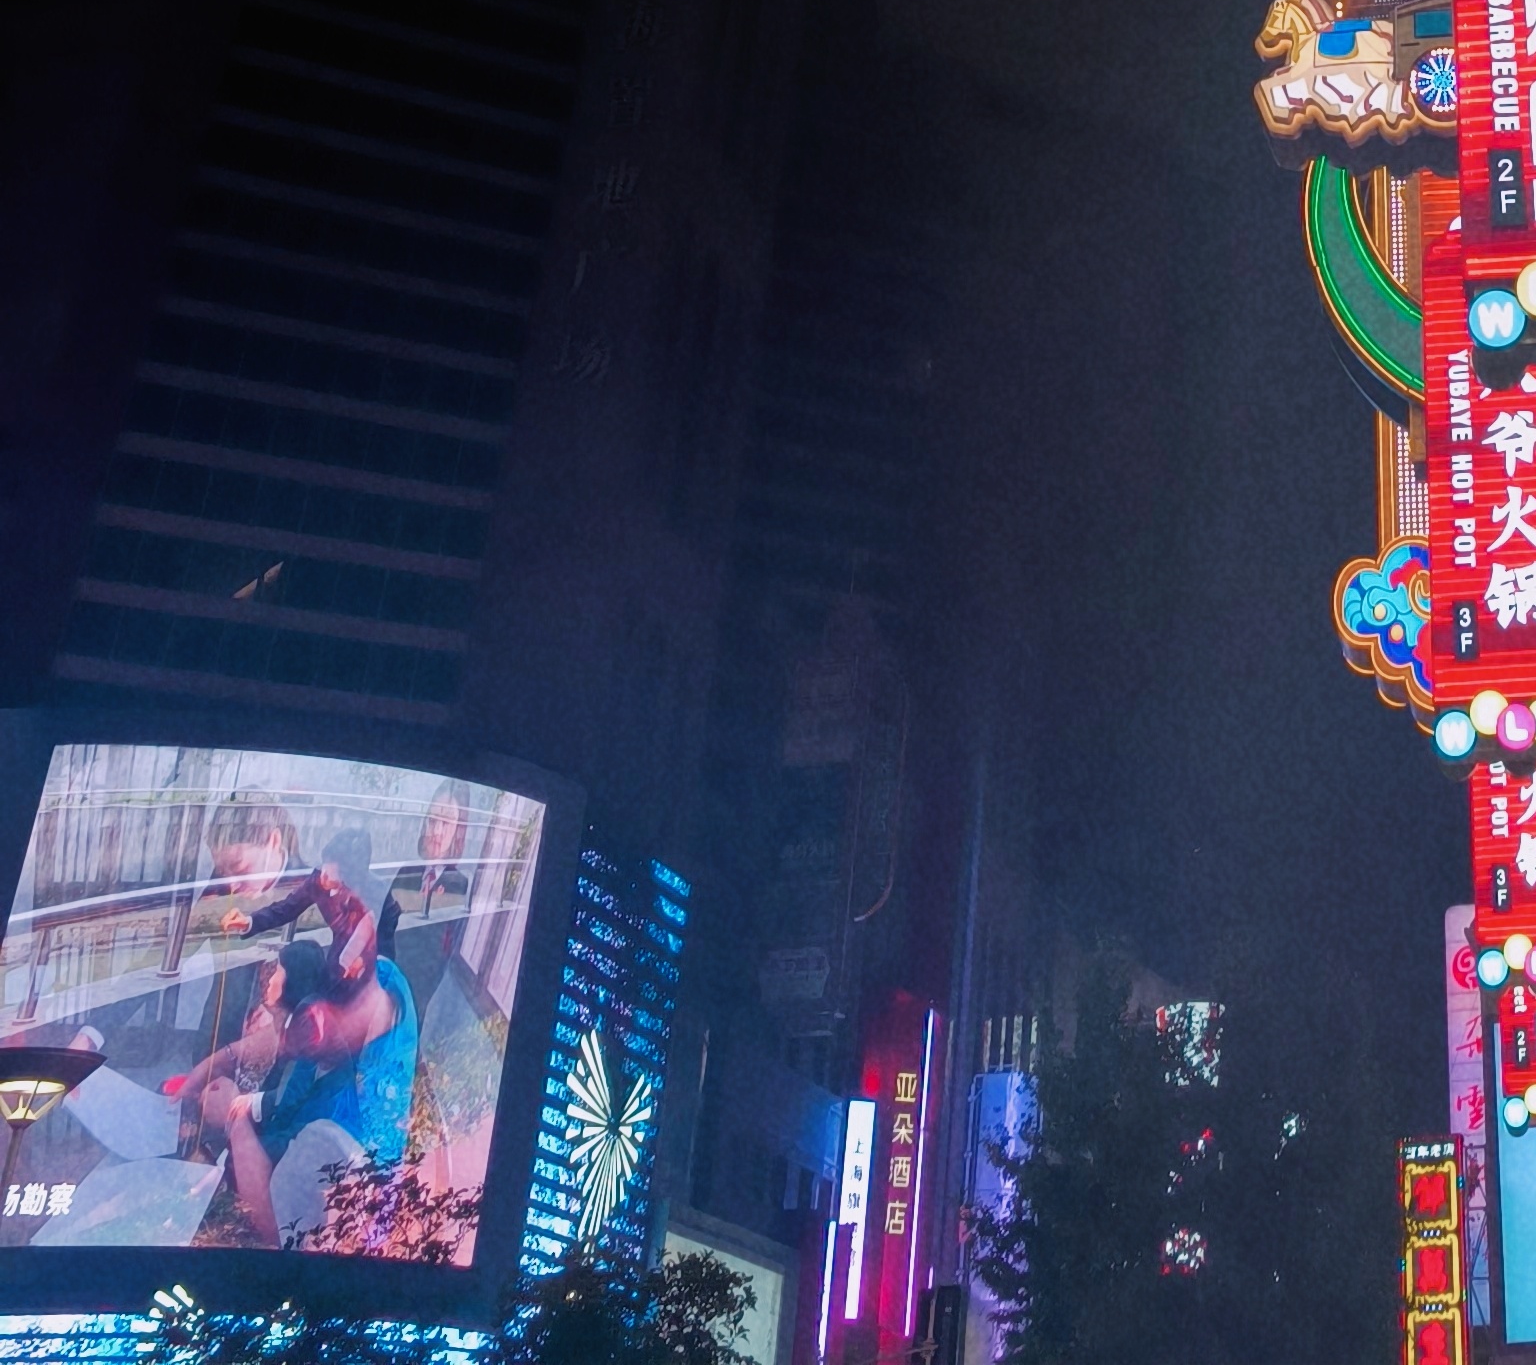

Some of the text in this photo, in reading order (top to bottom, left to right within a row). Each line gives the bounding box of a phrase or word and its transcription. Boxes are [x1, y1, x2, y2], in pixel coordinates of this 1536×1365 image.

[1497, 159, 1517, 215] 2F
[1448, 349, 1476, 568] YUBAYE HOT POT
[1459, 607, 1473, 653] 3F
[1491, 797, 1509, 838] POT
[1496, 869, 1507, 906] 3F
[1517, 1030, 1527, 1062] 2F
[885, 1072, 917, 1235] 亚朵酒店
